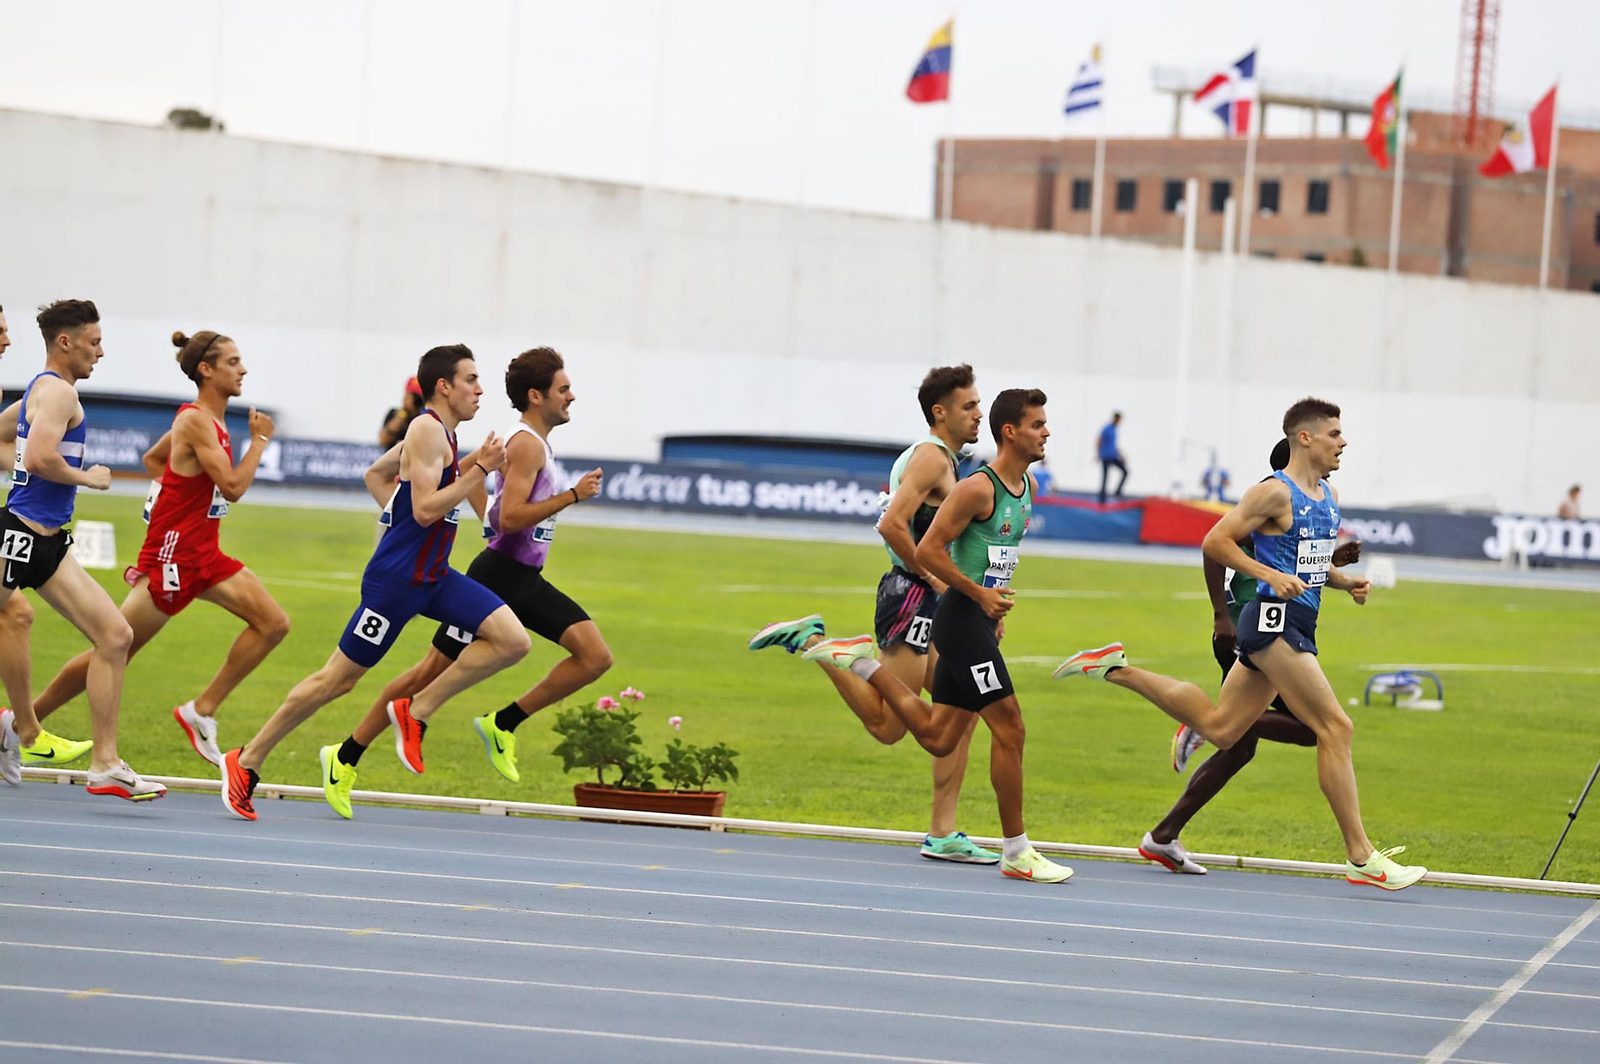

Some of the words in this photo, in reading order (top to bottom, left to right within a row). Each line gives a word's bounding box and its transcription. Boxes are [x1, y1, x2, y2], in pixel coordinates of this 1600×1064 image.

[696, 474, 751, 508] tus
[753, 479, 880, 517] sentido
[5, 534, 32, 559] 12
[361, 615, 383, 639] 8
[1265, 606, 1282, 629] 9
[912, 620, 931, 644] 13
[976, 665, 992, 688] 7
